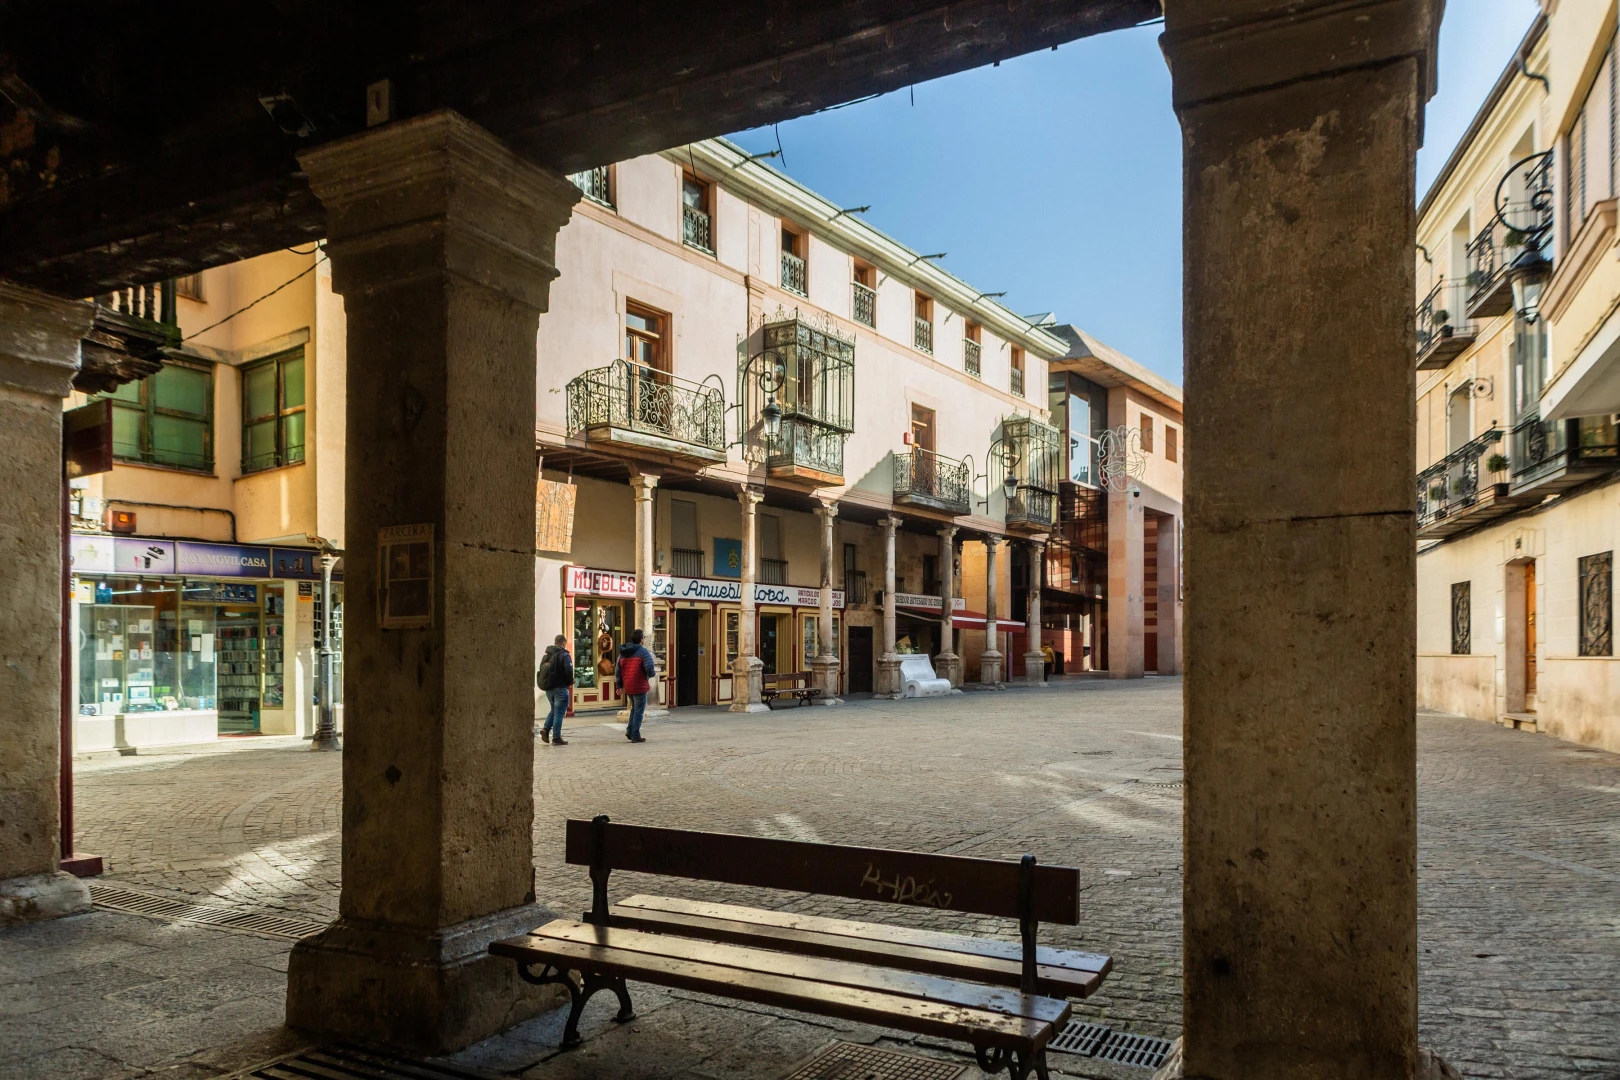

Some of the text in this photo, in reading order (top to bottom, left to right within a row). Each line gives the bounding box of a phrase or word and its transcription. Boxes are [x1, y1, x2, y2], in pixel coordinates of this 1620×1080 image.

[205, 554, 267, 567] MOVILCASA
[573, 570, 636, 593] MUEBLES
[651, 578, 790, 602] La Amuebldora
